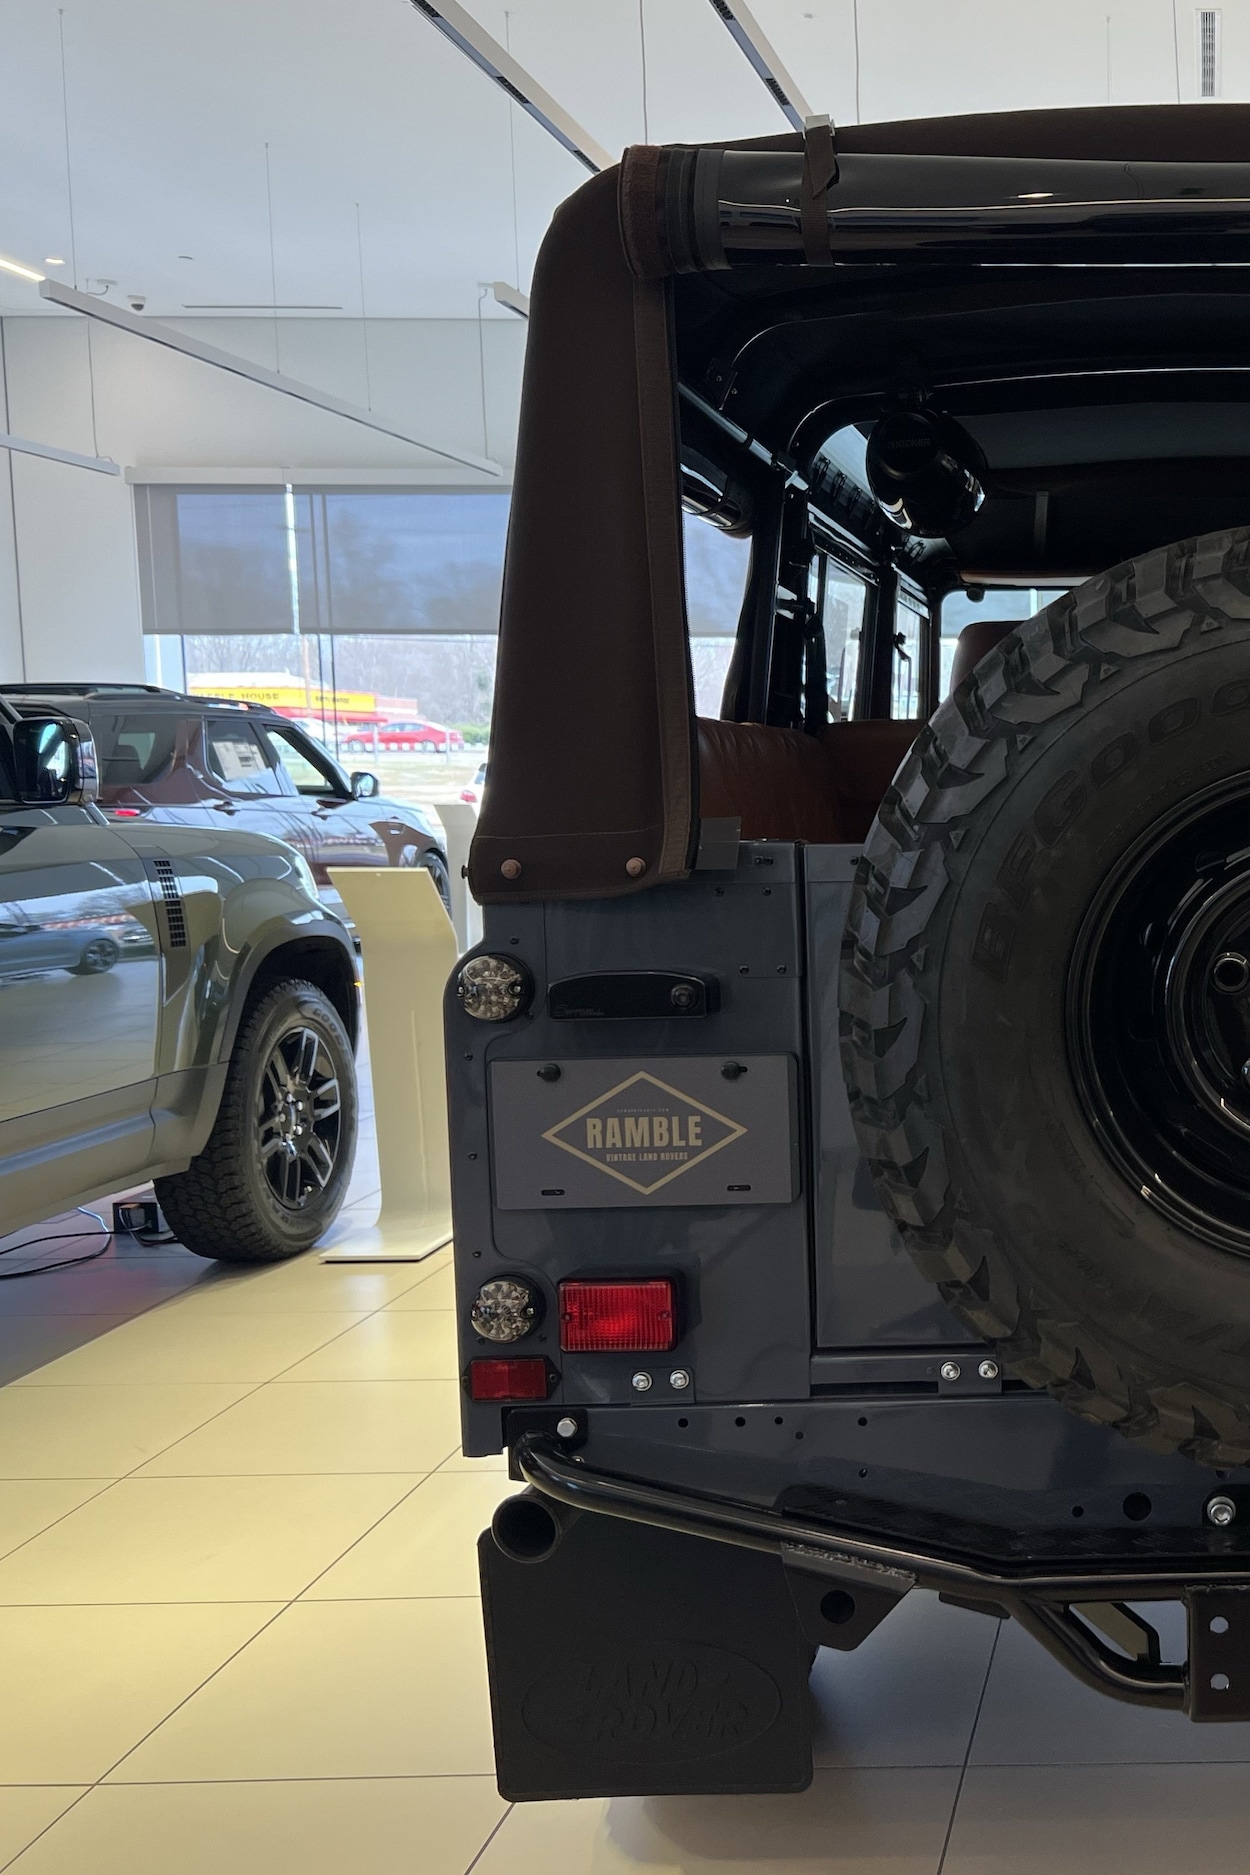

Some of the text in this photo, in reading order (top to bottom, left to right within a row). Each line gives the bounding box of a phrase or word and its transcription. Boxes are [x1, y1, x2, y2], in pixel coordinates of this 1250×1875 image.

[241, 692, 280, 700] HOUSE
[585, 1115, 703, 1149] RAMBLE
[605, 1151, 689, 1162] VINTAGE LAND ROVERS
